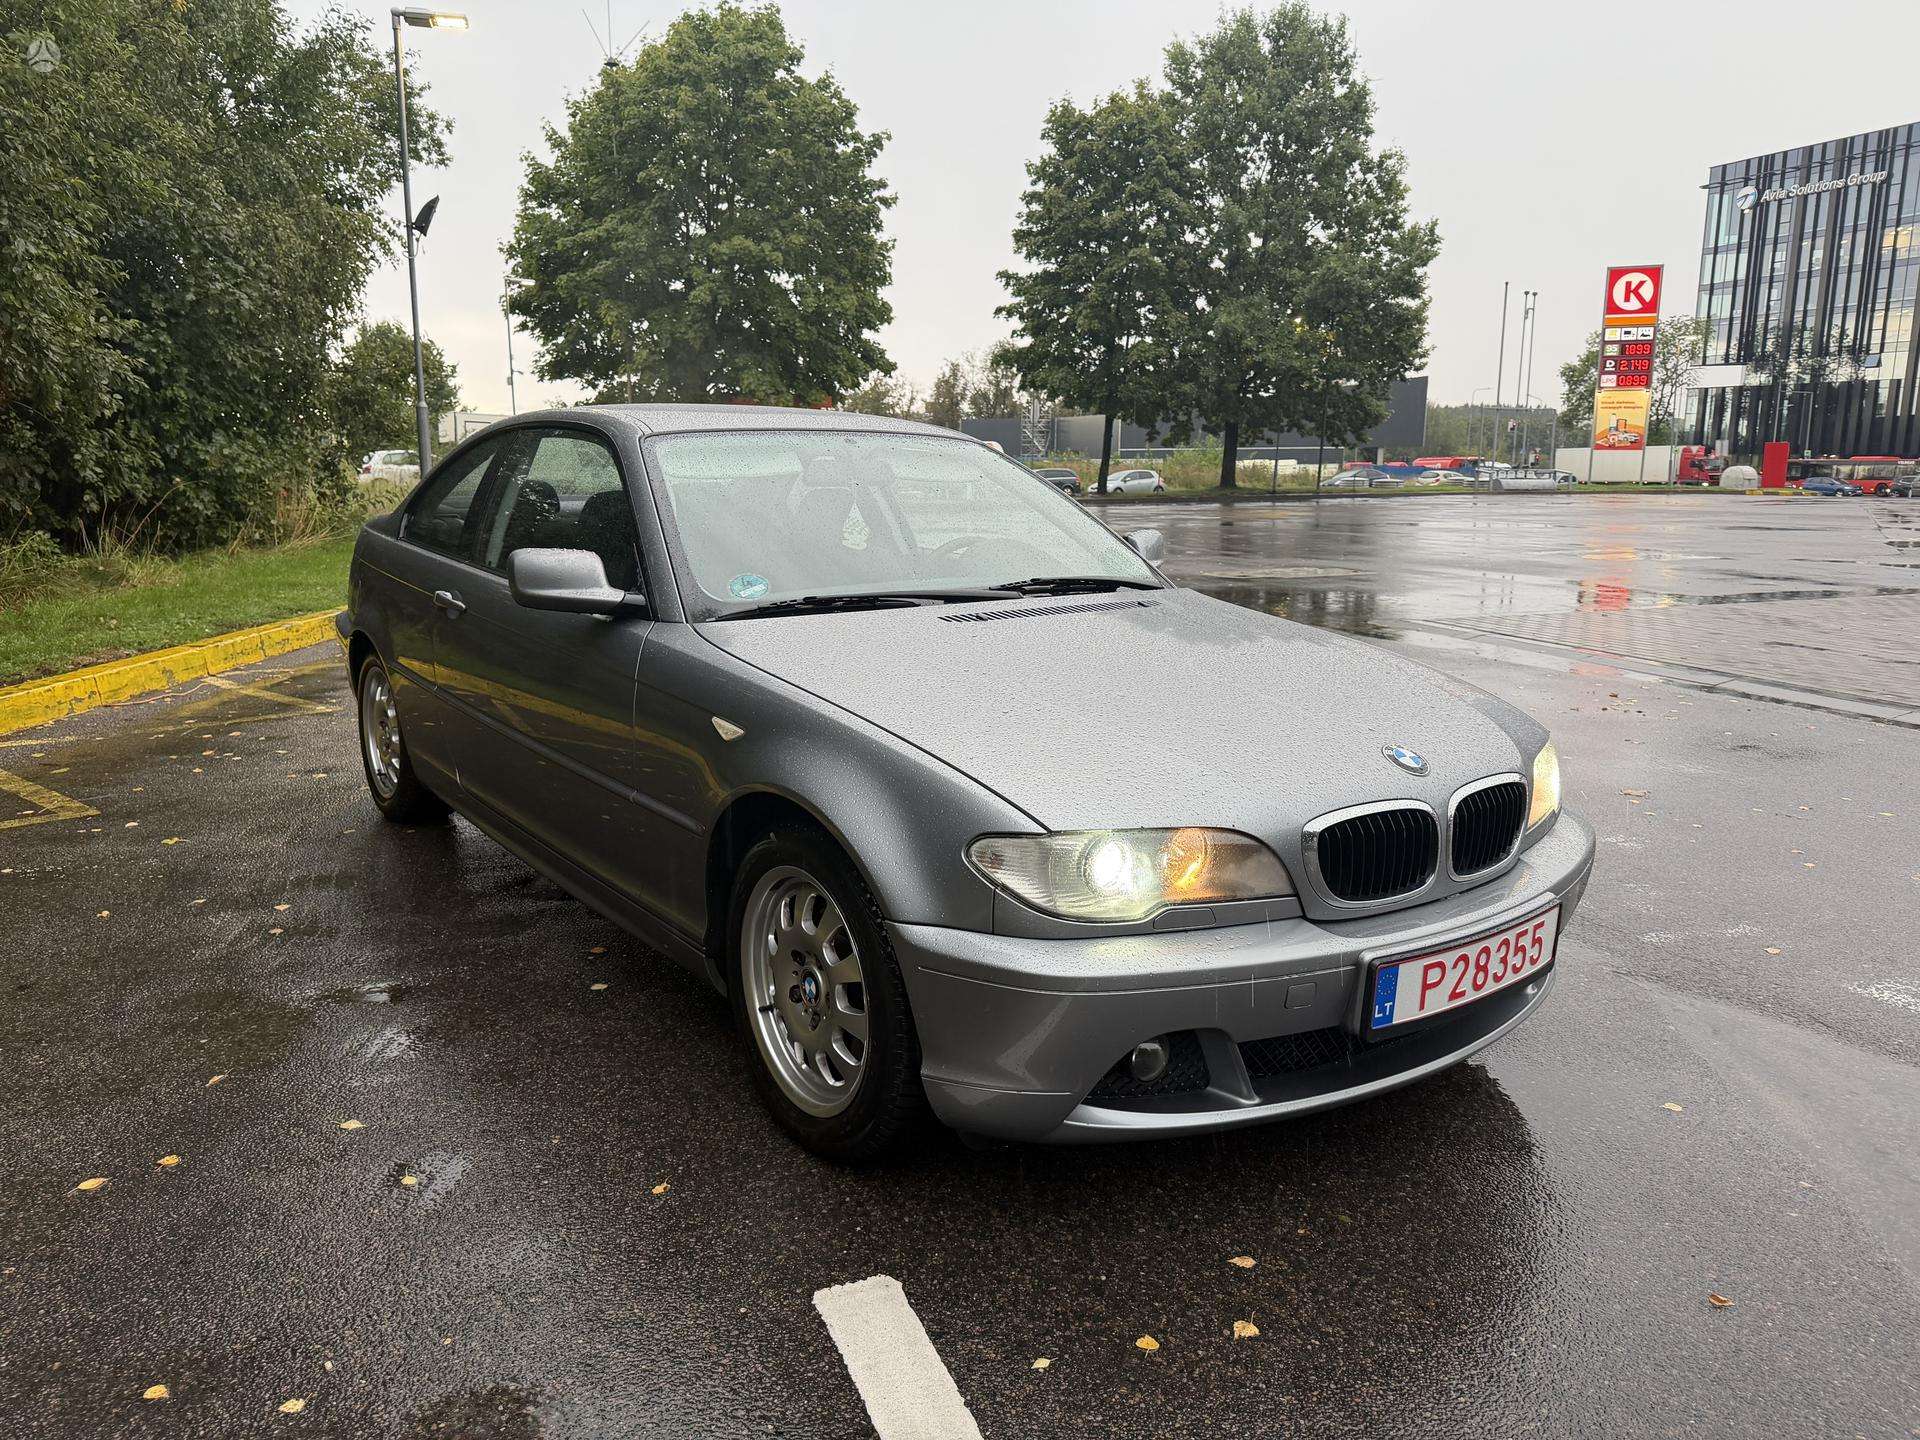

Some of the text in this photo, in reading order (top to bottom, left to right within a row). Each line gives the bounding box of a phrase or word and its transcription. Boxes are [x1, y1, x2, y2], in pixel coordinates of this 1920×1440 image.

[1760, 170, 1888, 202] Avia Solutions Group
[1605, 359, 1616, 368] D
[1374, 920, 1545, 1018] LT P28355
